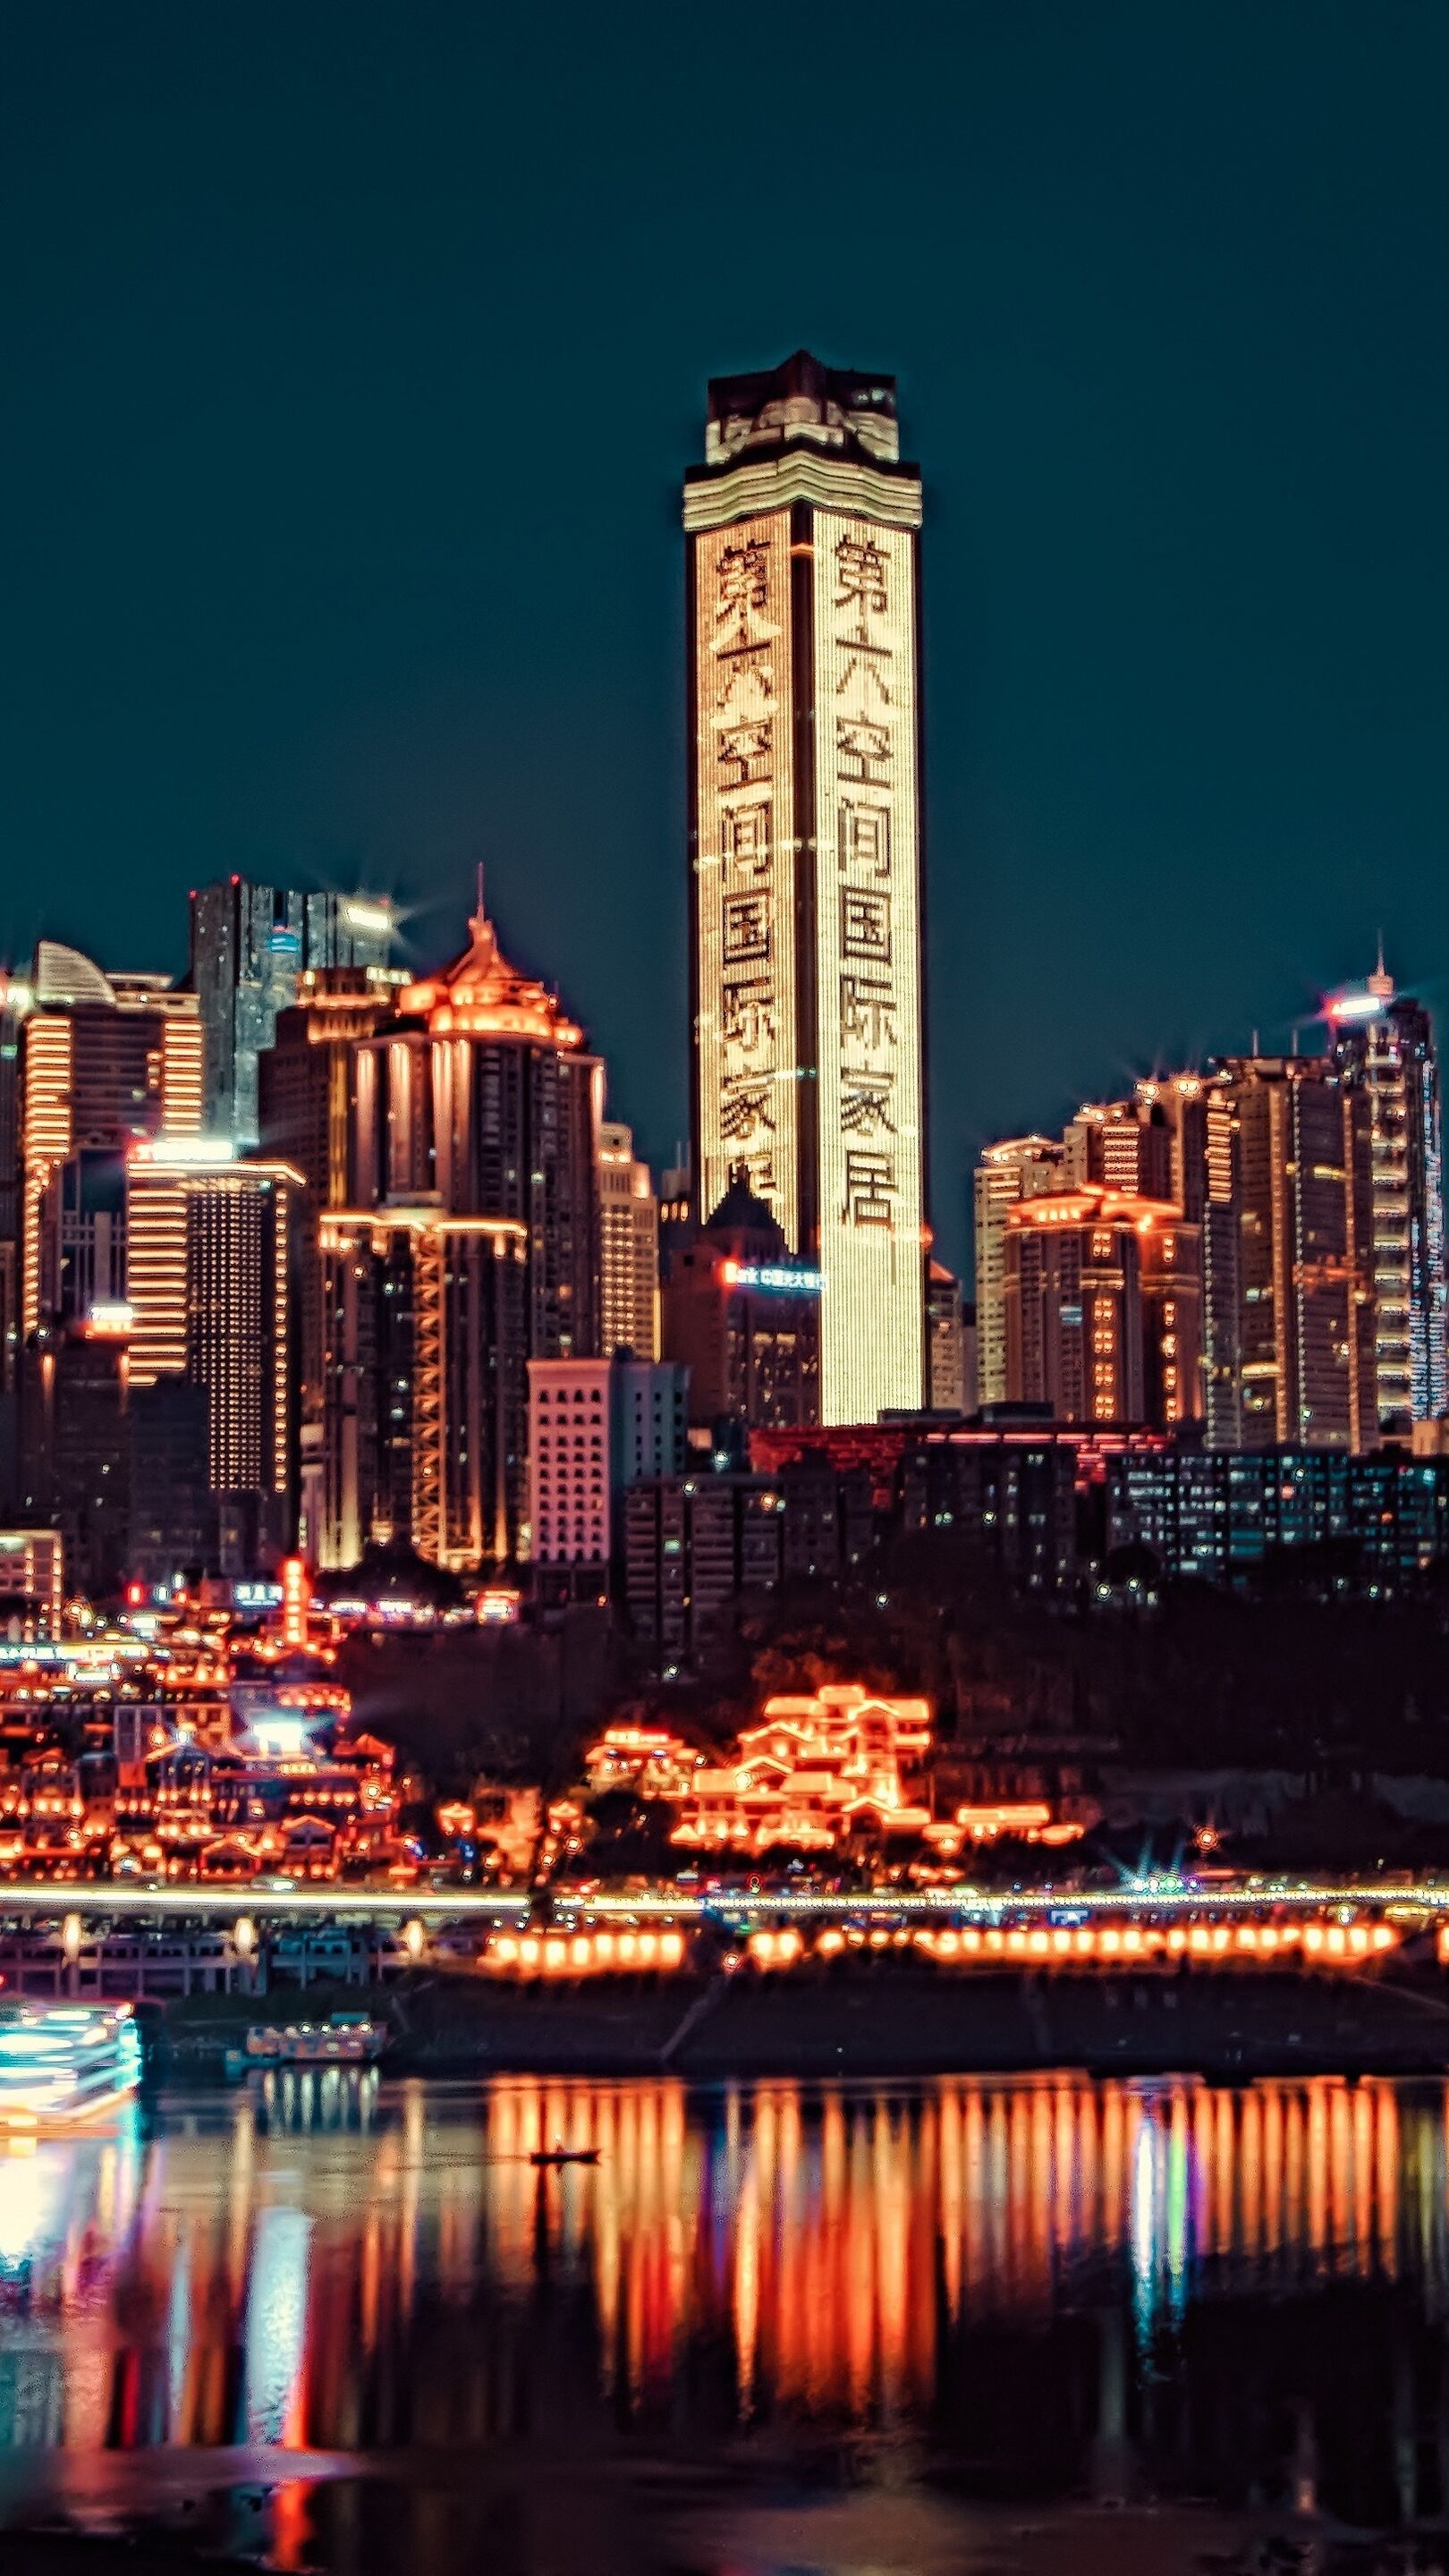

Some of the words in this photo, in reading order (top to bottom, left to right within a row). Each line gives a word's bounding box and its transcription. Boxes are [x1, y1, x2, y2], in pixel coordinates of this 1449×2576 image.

[835, 535, 896, 1227] 第六空间国际家居
